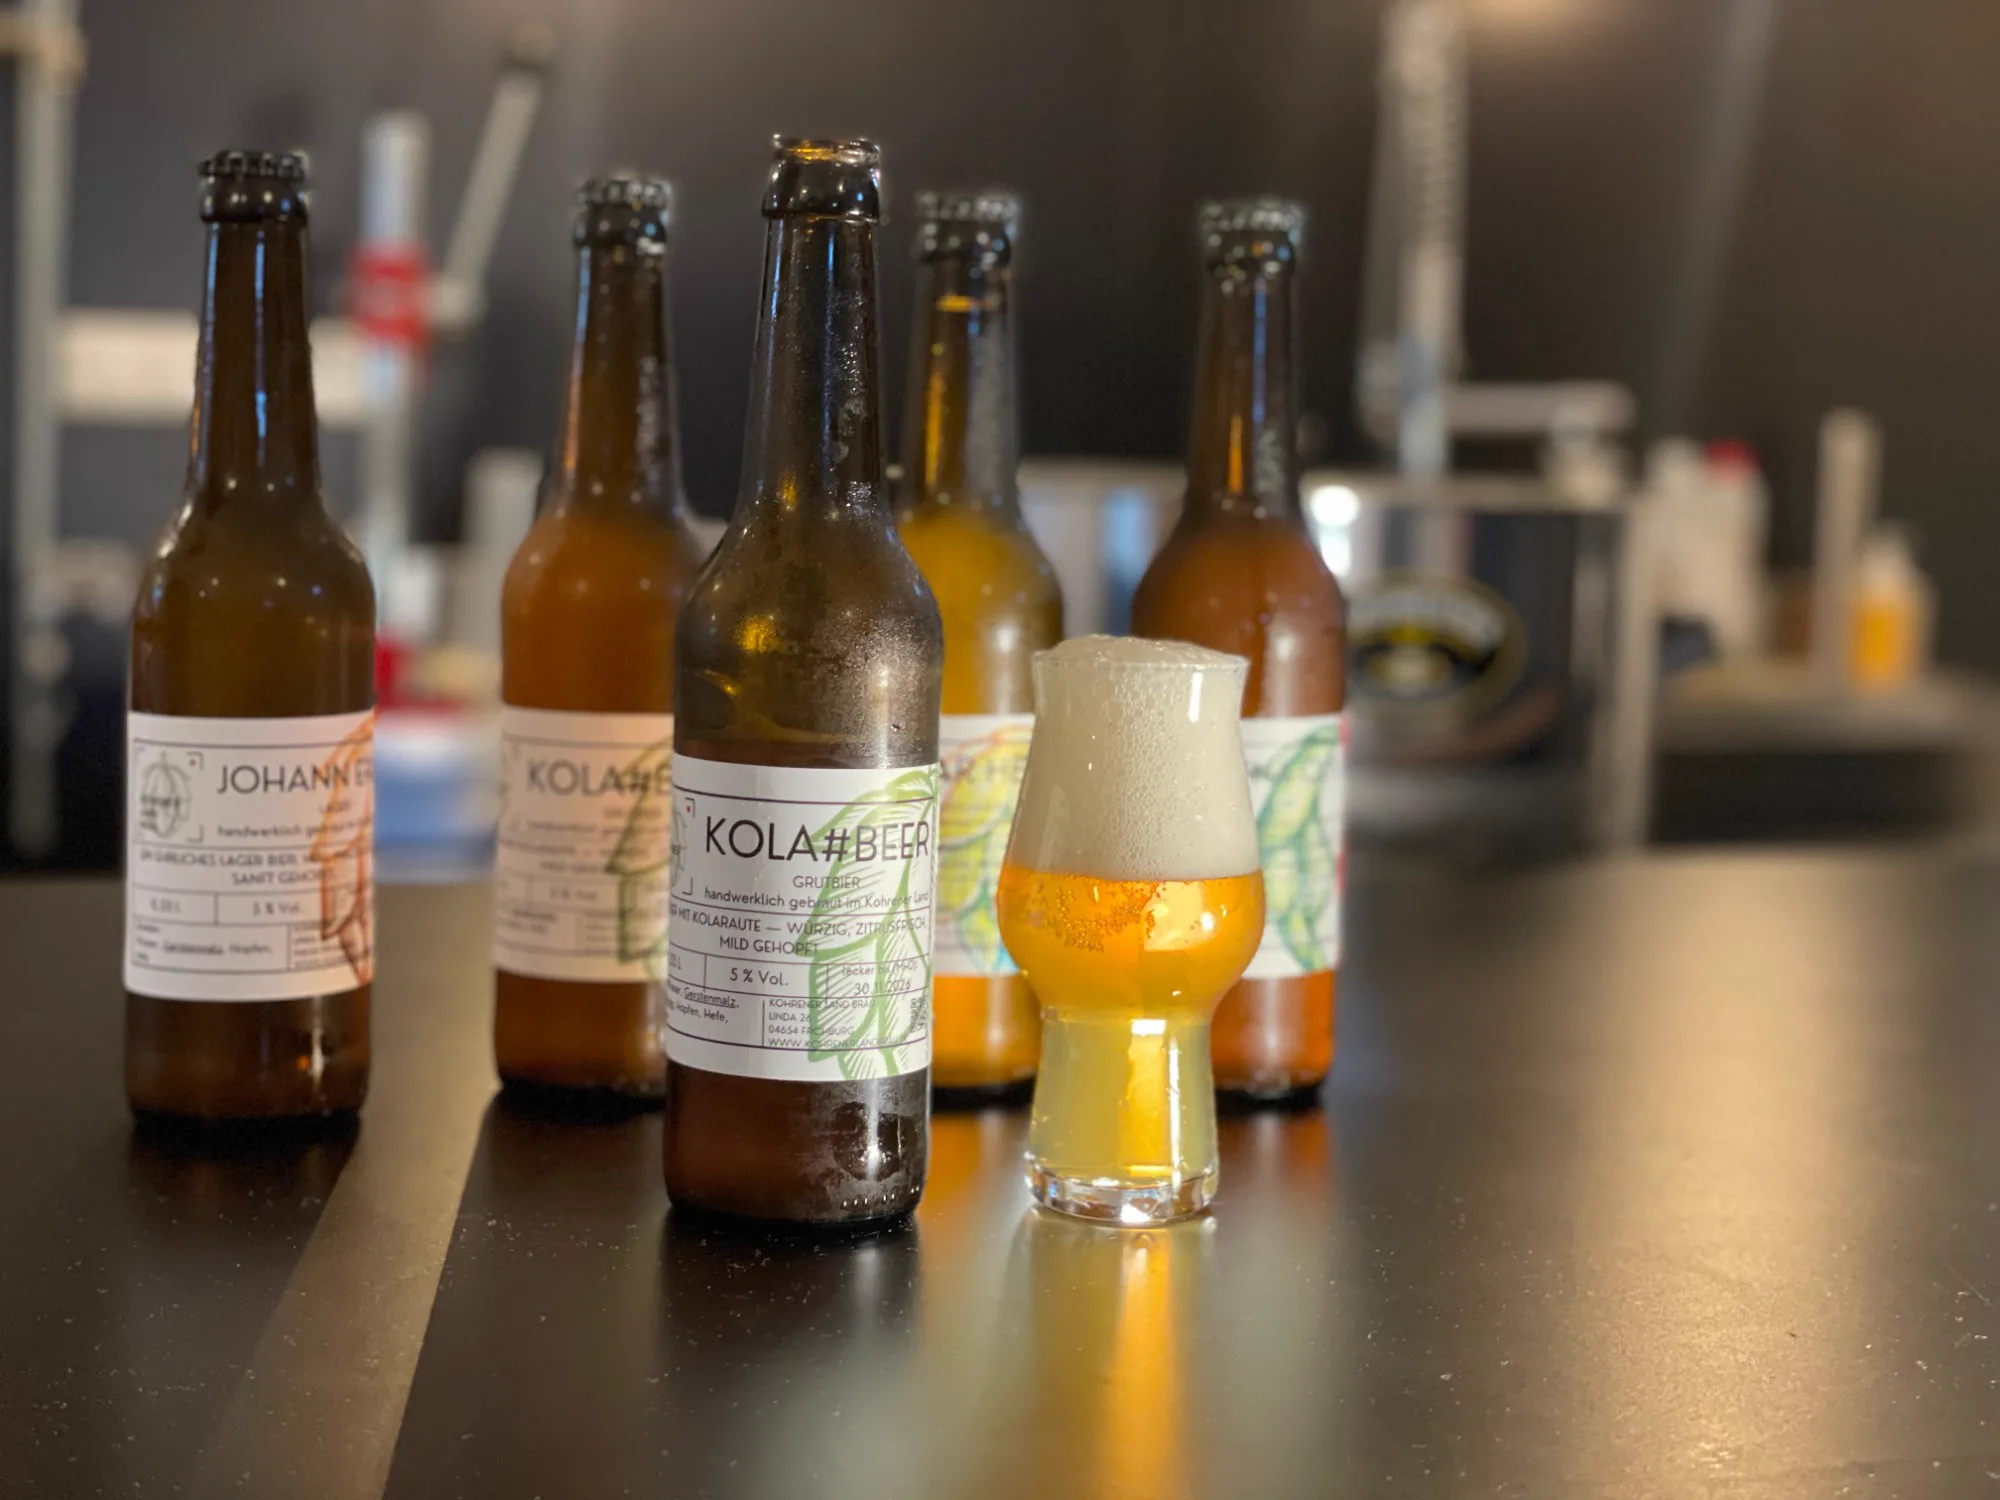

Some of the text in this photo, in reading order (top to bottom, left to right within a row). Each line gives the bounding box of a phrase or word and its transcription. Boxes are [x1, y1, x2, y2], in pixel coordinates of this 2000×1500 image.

[217, 763, 349, 793] JOHANN
[705, 815, 930, 862] KOLA#BEER
[792, 875, 862, 889] GRUTBIER
[704, 886, 785, 908] handwerklich
[789, 895, 844, 911] gebraut
[846, 898, 861, 909] im
[692, 911, 761, 932] KOLARAUTE
[720, 935, 818, 955] MILD GEHOPFT
[730, 967, 789, 986] 5 % Vol.
[684, 987, 740, 1009] Gerstenmalz,
[704, 1008, 729, 1023] Hefe,
[768, 1012, 797, 1022] LINDA
